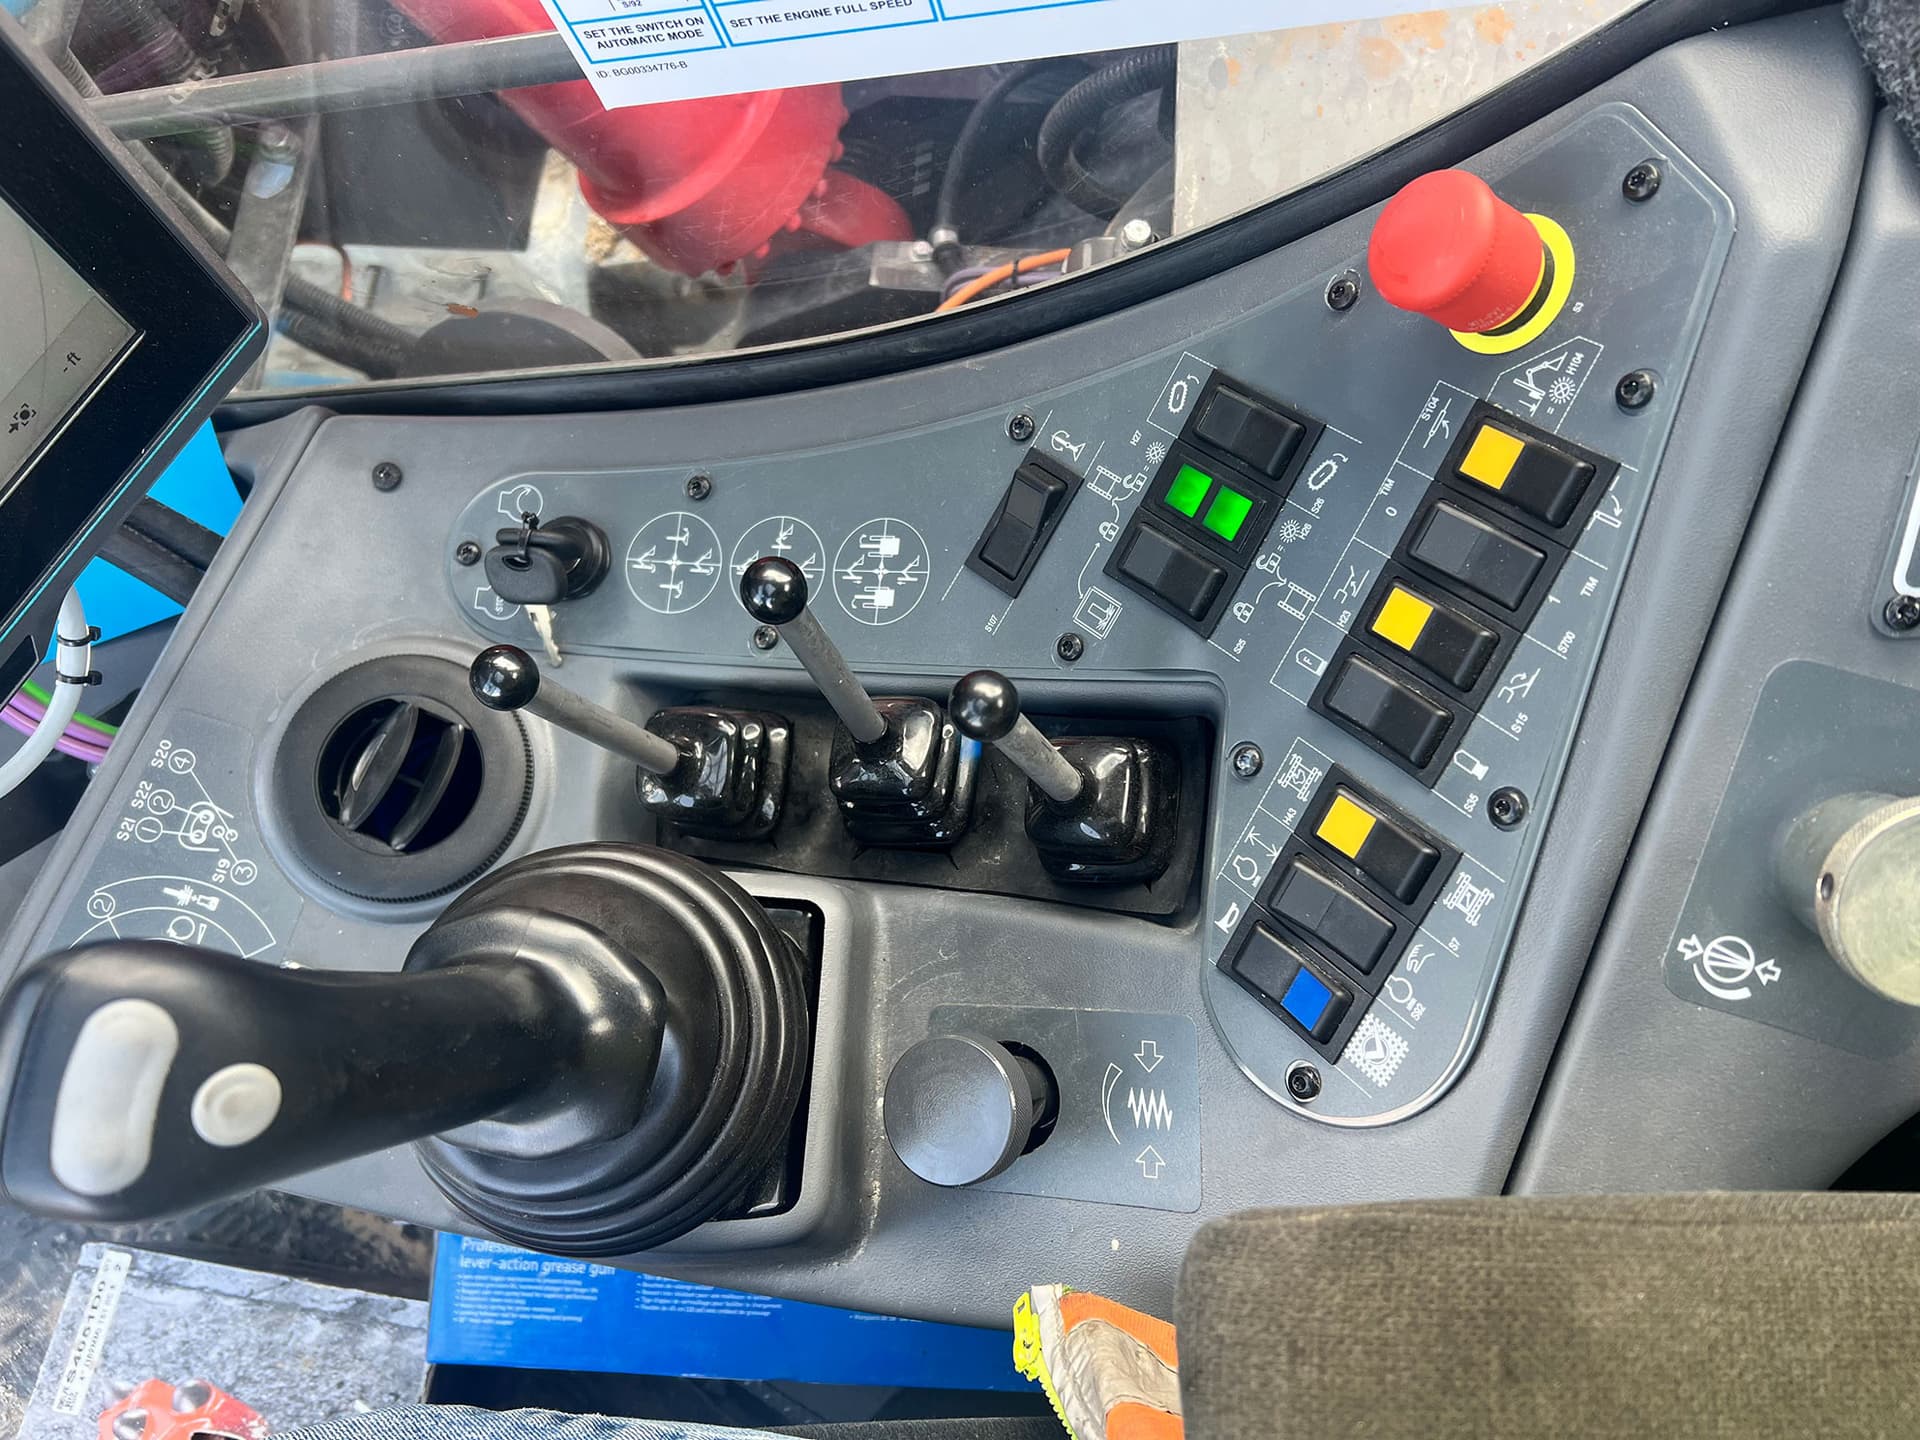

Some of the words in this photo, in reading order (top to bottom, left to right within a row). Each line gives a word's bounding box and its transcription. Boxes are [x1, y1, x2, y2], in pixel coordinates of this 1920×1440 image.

[729, 17, 753, 29] SET
[756, 13, 782, 25] THE
[785, 7, 832, 22] ENGINE
[835, 3, 868, 16] FULL
[869, 0, 913, 10] SPEED
[583, 29, 606, 40] SET
[611, 25, 635, 37] THE
[635, 19, 684, 33] SWITCH
[685, 16, 704, 26] ON
[597, 34, 665, 50] AUTOMATIC
[668, 29, 704, 41] MODE
[596, 70, 611, 79] ID:
[612, 60, 688, 78] BG00334776-B
[66, 352, 81, 366] ft
[1565, 352, 1585, 375] H104
[1420, 396, 1440, 421] S104
[1129, 430, 1143, 445] H27
[1380, 480, 1396, 497] TIM
[1310, 497, 1325, 514] S26
[1580, 576, 1599, 597] TIM
[1548, 594, 1560, 604] 1
[984, 613, 999, 633] S107
[1336, 610, 1352, 628] H23
[1233, 638, 1246, 655] S25
[1557, 630, 1576, 654] S700
[1510, 711, 1529, 734] S15
[151, 739, 173, 768] S20
[174, 752, 190, 768] 4
[131, 780, 153, 809] S22
[152, 795, 171, 810] 2
[1463, 793, 1480, 813] S35
[1282, 807, 1297, 825] H43
[116, 816, 137, 842] S21
[211, 858, 231, 883] S19
[235, 864, 254, 879] 3
[93, 898, 112, 912] 2
[1448, 936, 1461, 951] S7
[460, 1254, 539, 1273] lever-action
[541, 1258, 586, 1277] grease
[588, 1263, 616, 1277] gun
